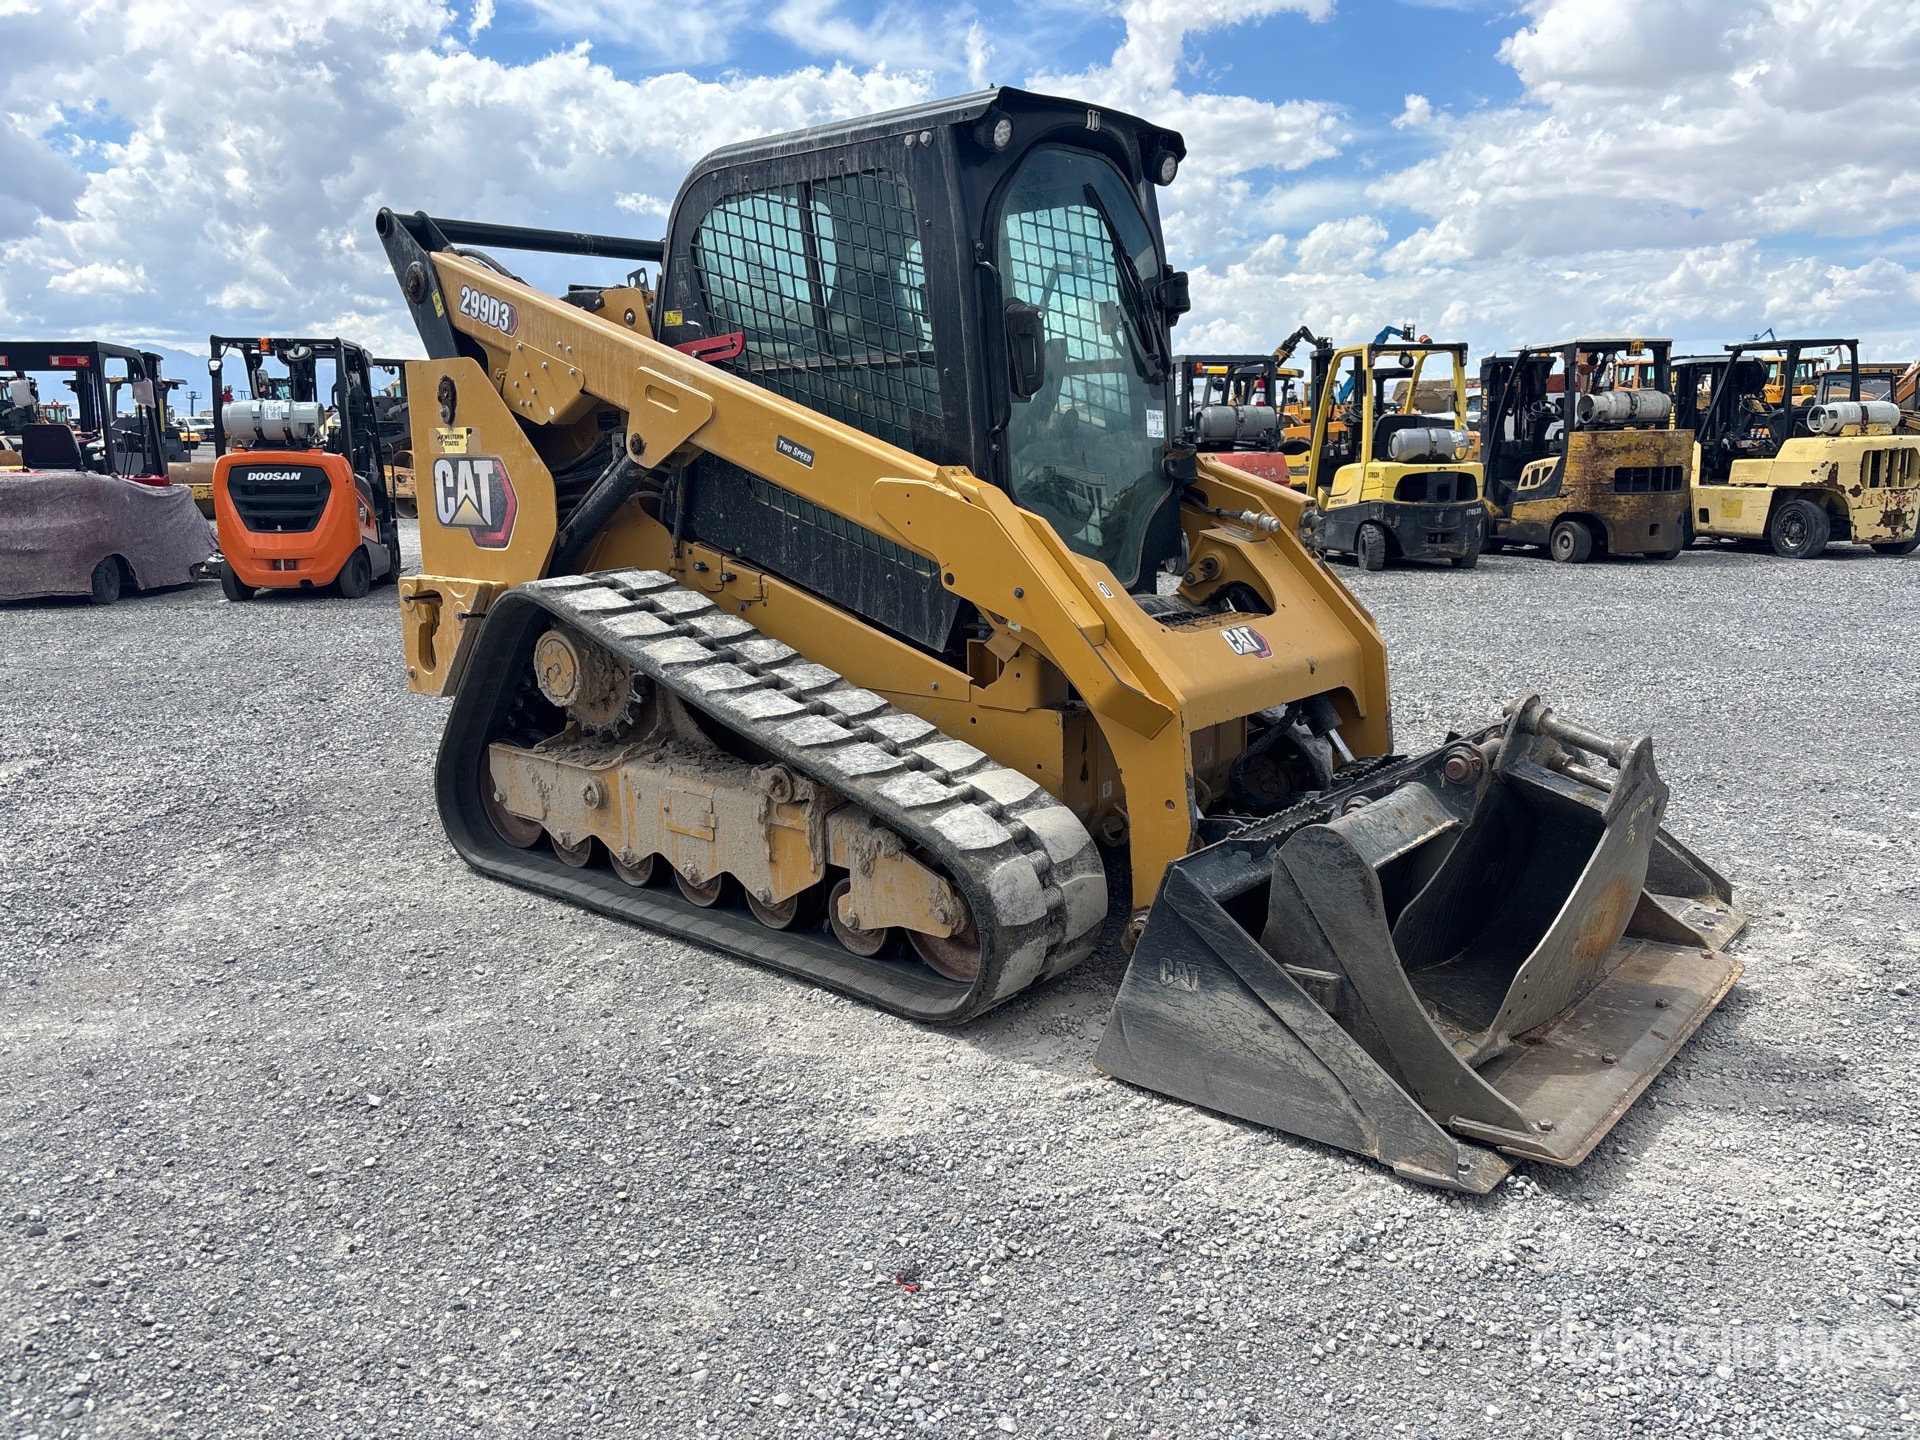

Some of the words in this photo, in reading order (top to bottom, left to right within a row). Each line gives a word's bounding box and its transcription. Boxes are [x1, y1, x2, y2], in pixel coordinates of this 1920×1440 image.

[460, 285, 510, 331] 299D3
[247, 472, 301, 481] DOOSAN
[434, 459, 494, 526] CAT
[1222, 626, 1260, 656] CAT
[1159, 957, 1201, 992] CAT
